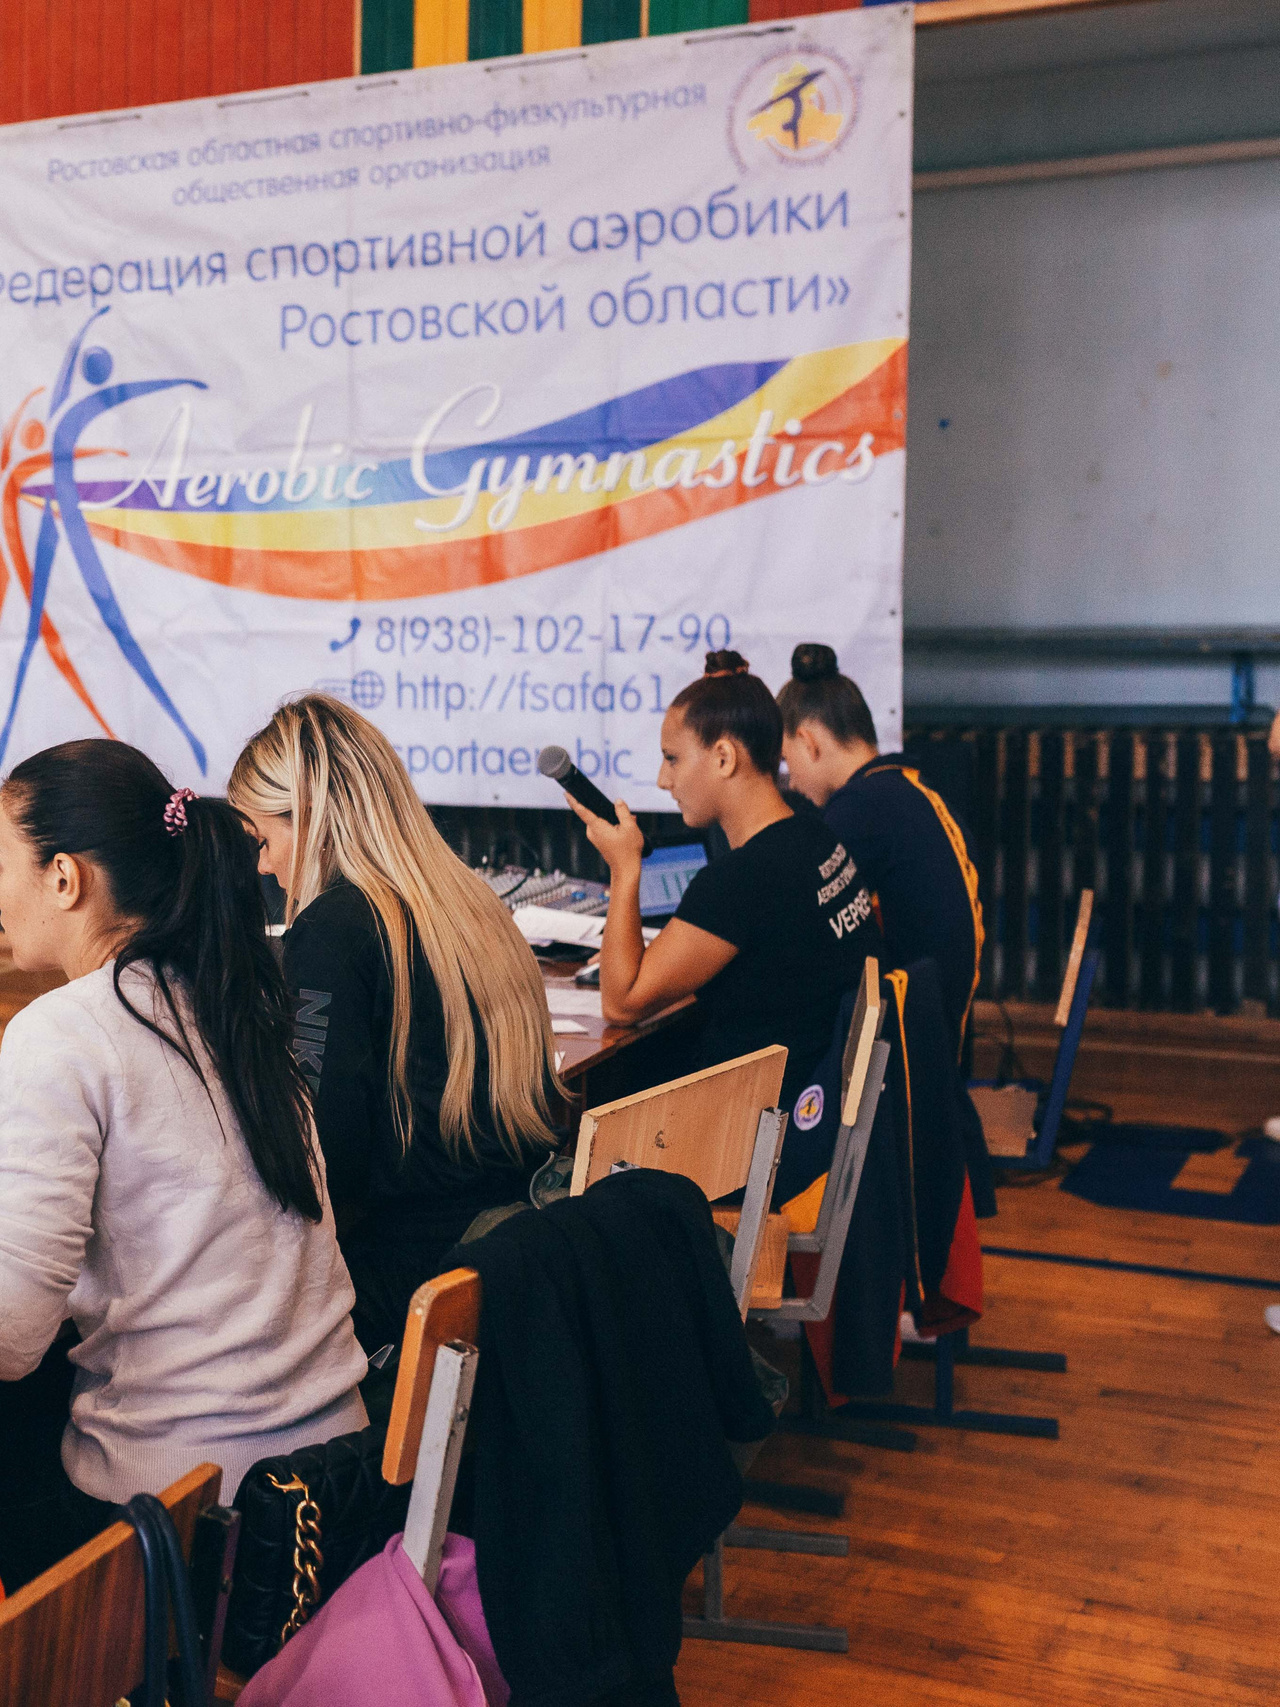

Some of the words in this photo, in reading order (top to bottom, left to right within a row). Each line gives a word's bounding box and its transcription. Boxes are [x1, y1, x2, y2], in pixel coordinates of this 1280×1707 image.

[47, 149, 180, 183] Ростовская
[186, 132, 320, 168] областная
[328, 82, 708, 151] спортивно-физкультурная
[172, 166, 360, 206] общественная
[369, 144, 551, 190] организация
[245, 209, 547, 288] спортивной
[568, 184, 850, 263] аэробики
[281, 282, 565, 350] Ростовской
[588, 271, 852, 329] области»
[77, 402, 380, 510] Aerobic
[410, 380, 877, 533] Gymnastics
[374, 612, 732, 657] 8(938)-102-17-90
